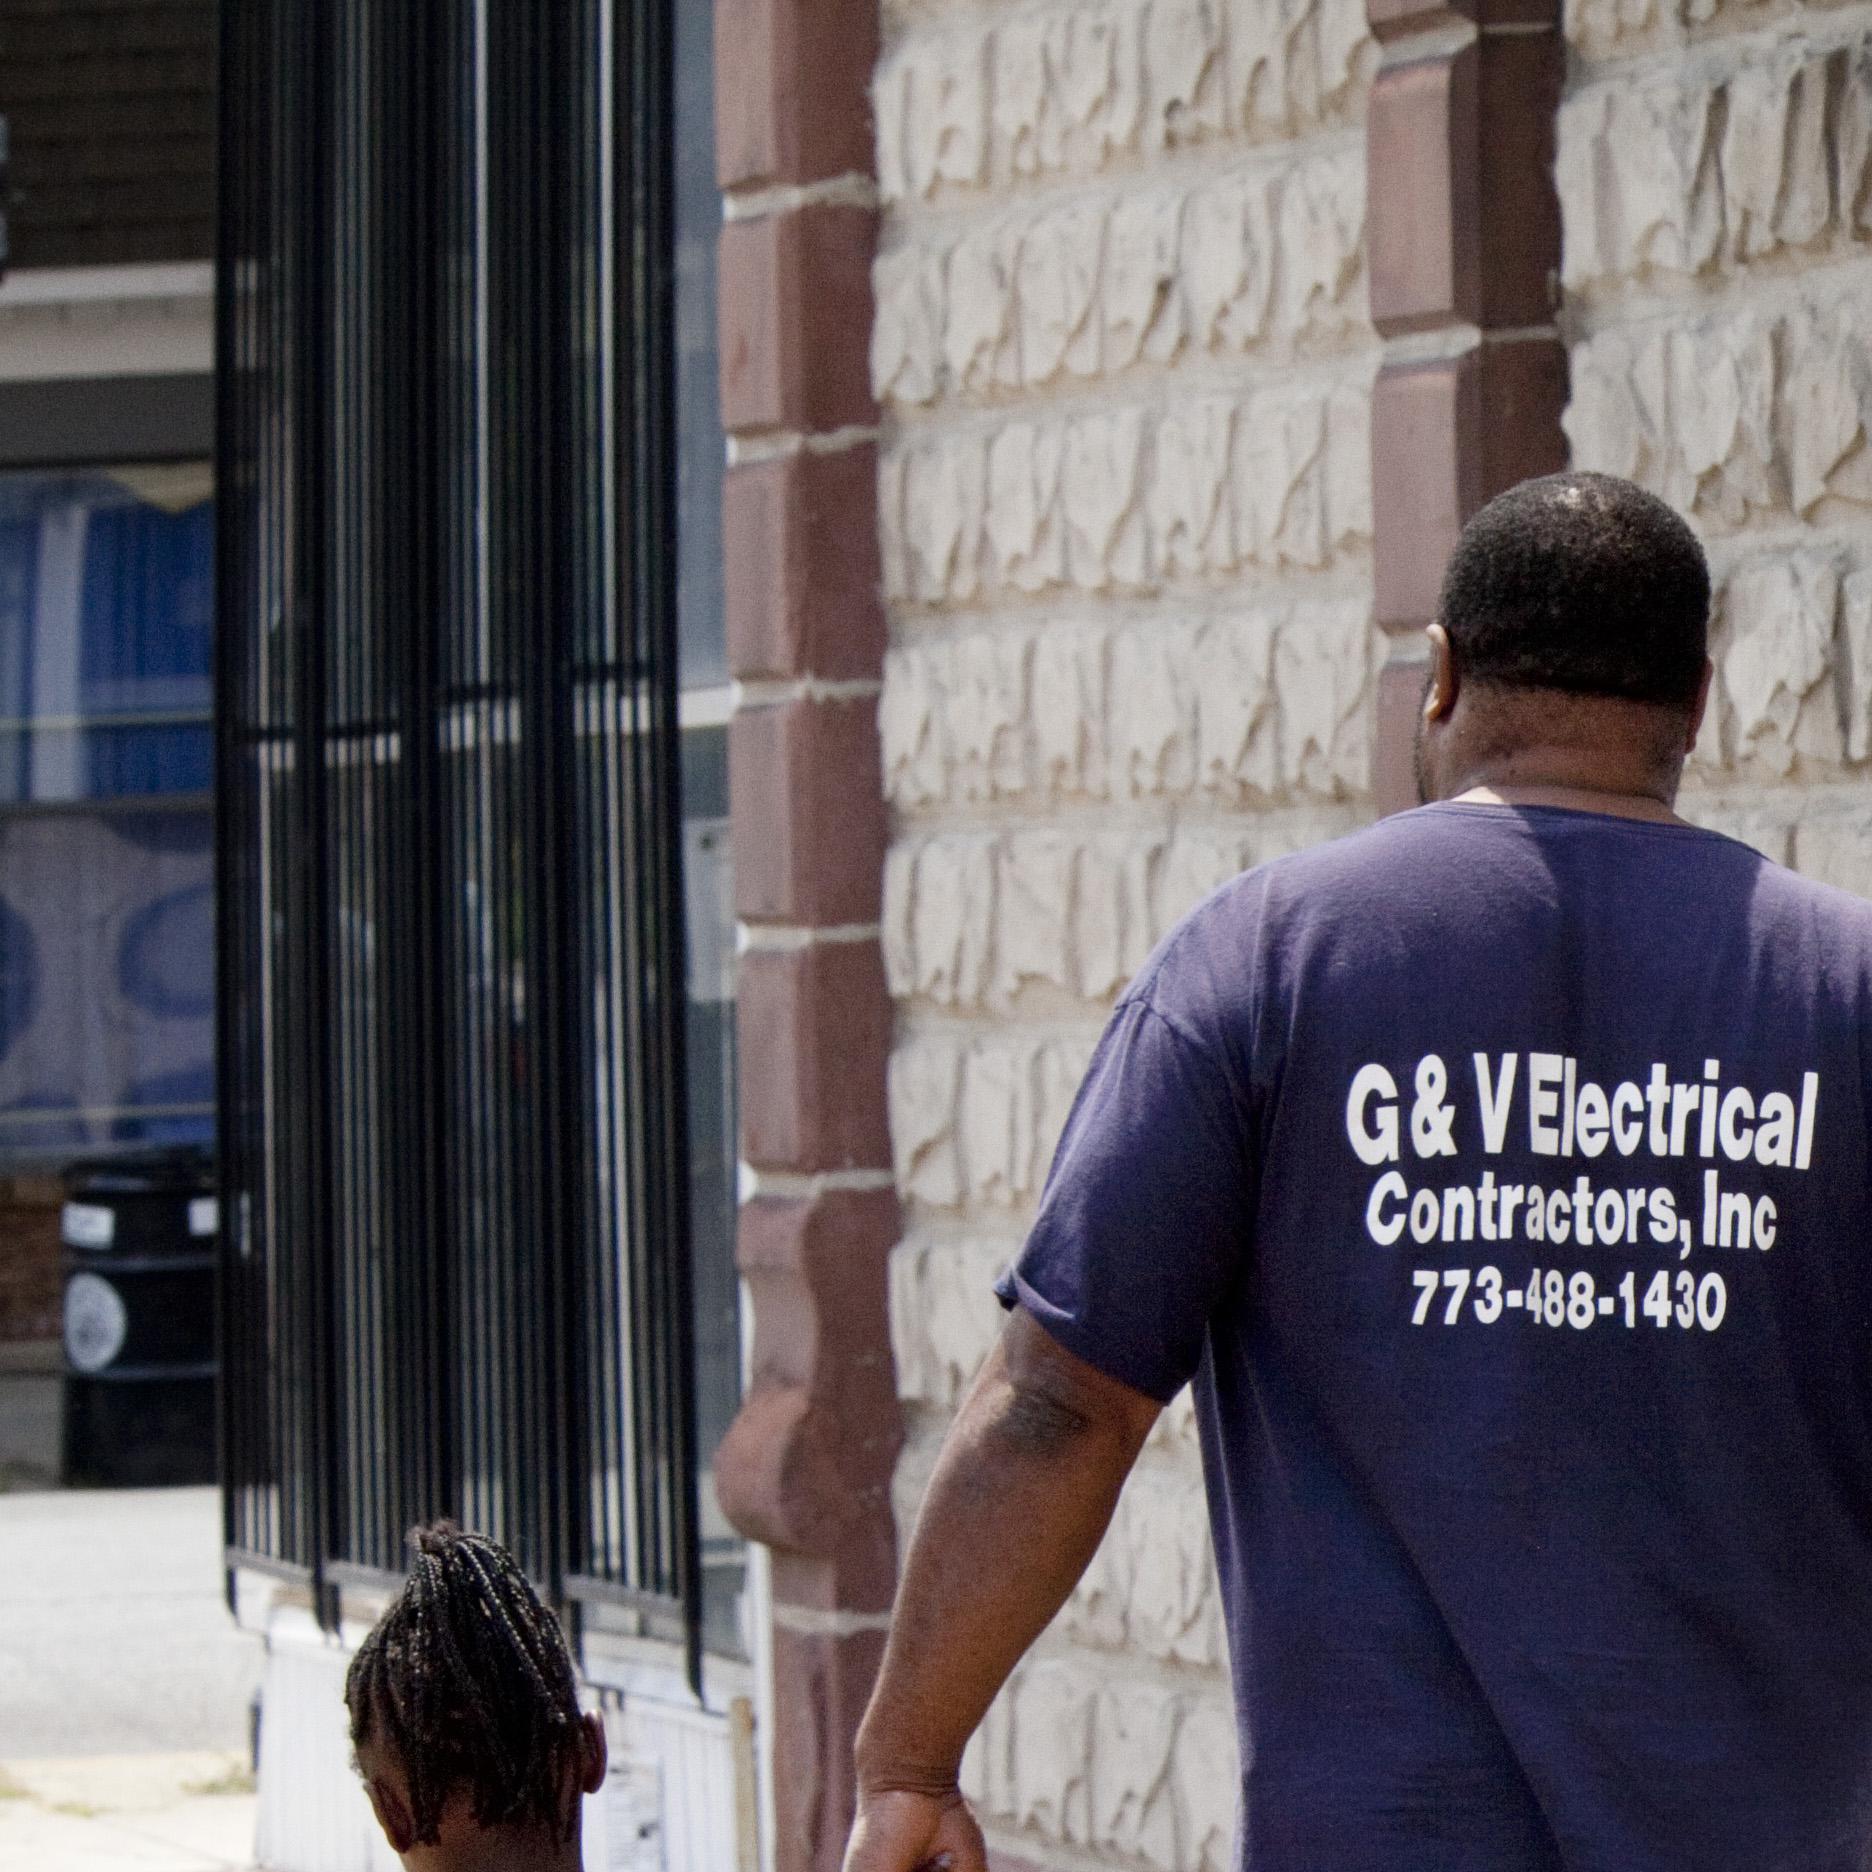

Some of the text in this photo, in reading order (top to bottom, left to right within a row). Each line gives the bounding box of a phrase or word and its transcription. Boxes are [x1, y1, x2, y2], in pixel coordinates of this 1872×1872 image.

[1346, 1052, 1818, 1169] G & V Electrical
[1366, 1169, 1777, 1260] Contractors, Inc
[1411, 1265, 1727, 1331] 773-488-1430
